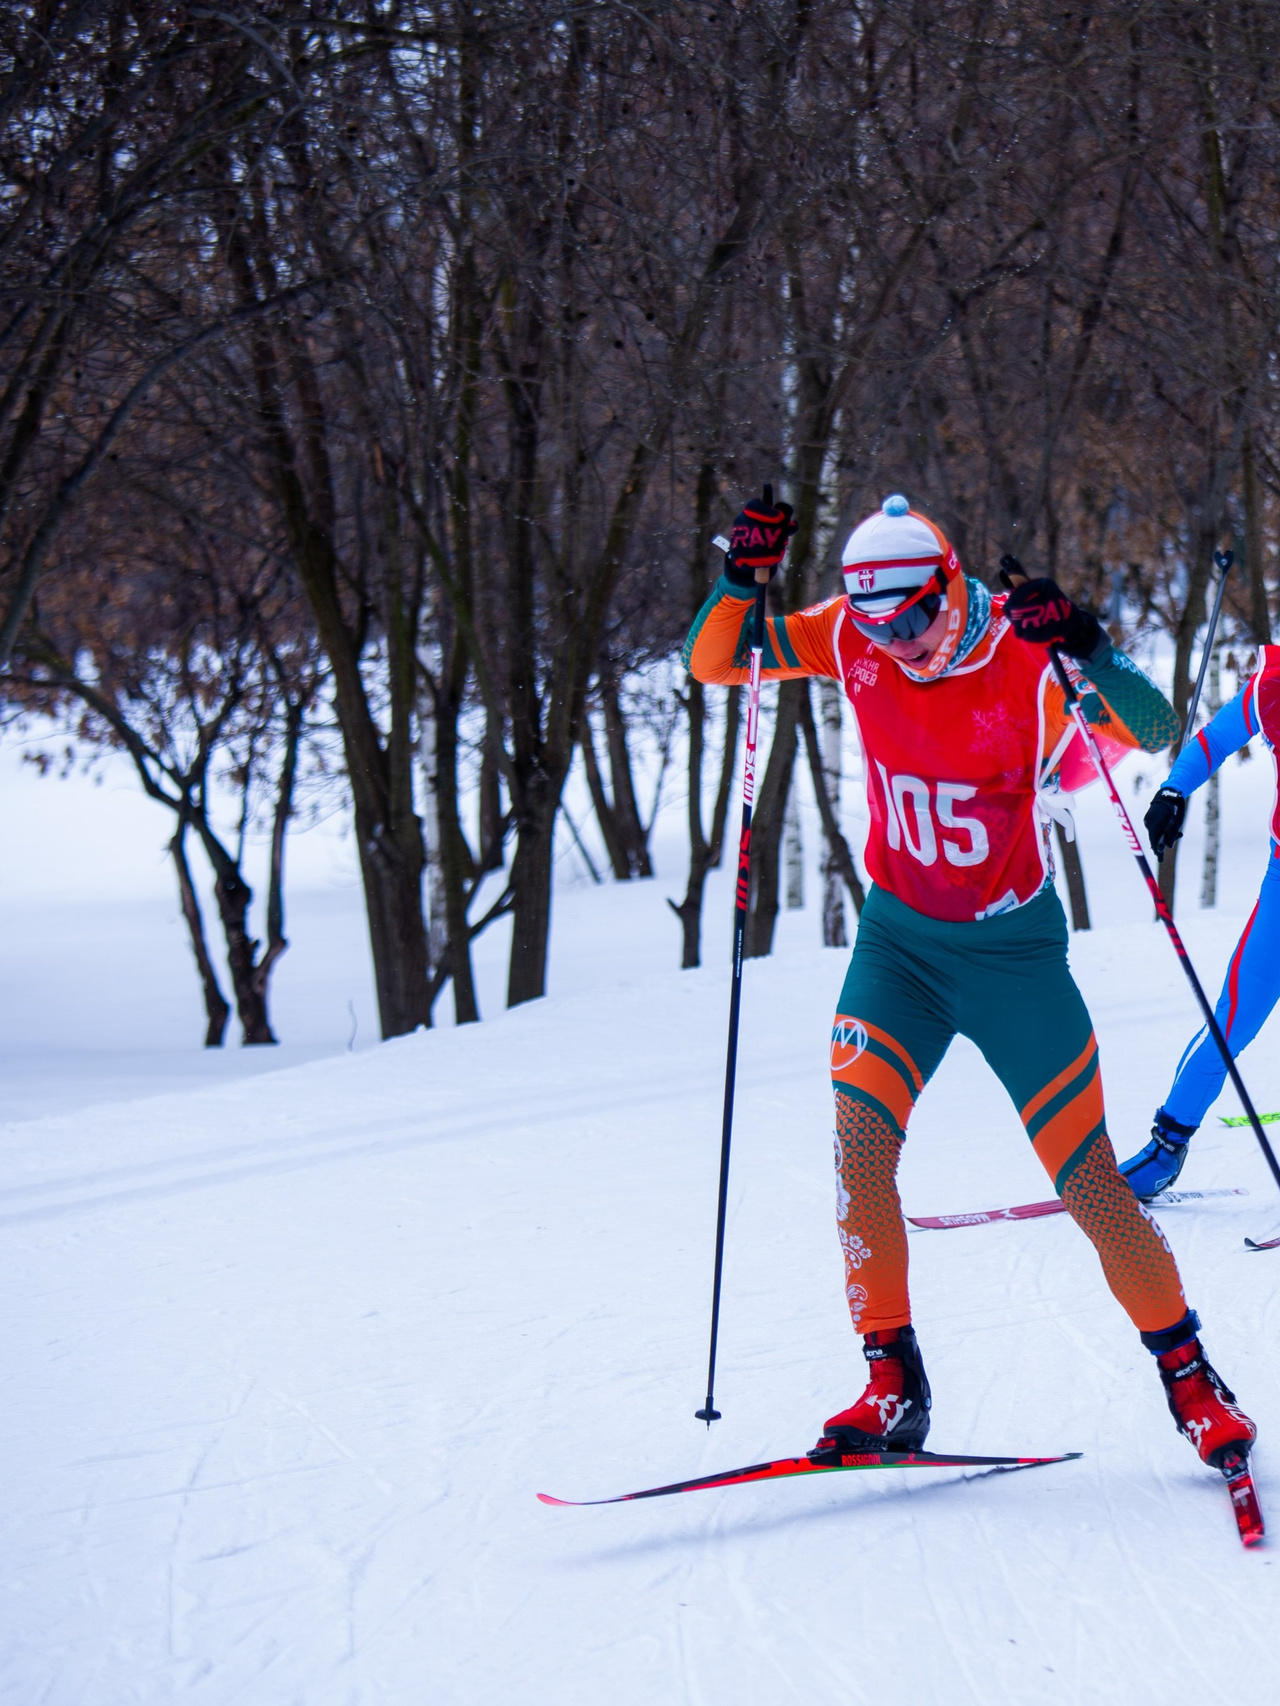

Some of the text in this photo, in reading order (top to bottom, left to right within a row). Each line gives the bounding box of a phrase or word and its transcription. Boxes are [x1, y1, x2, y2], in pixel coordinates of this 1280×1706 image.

[874, 757, 990, 867] 105
[938, 1212, 991, 1227] MADSHUS
[1175, 1361, 1198, 1378] alpina
[841, 1453, 881, 1467] ROSSIGNOL
